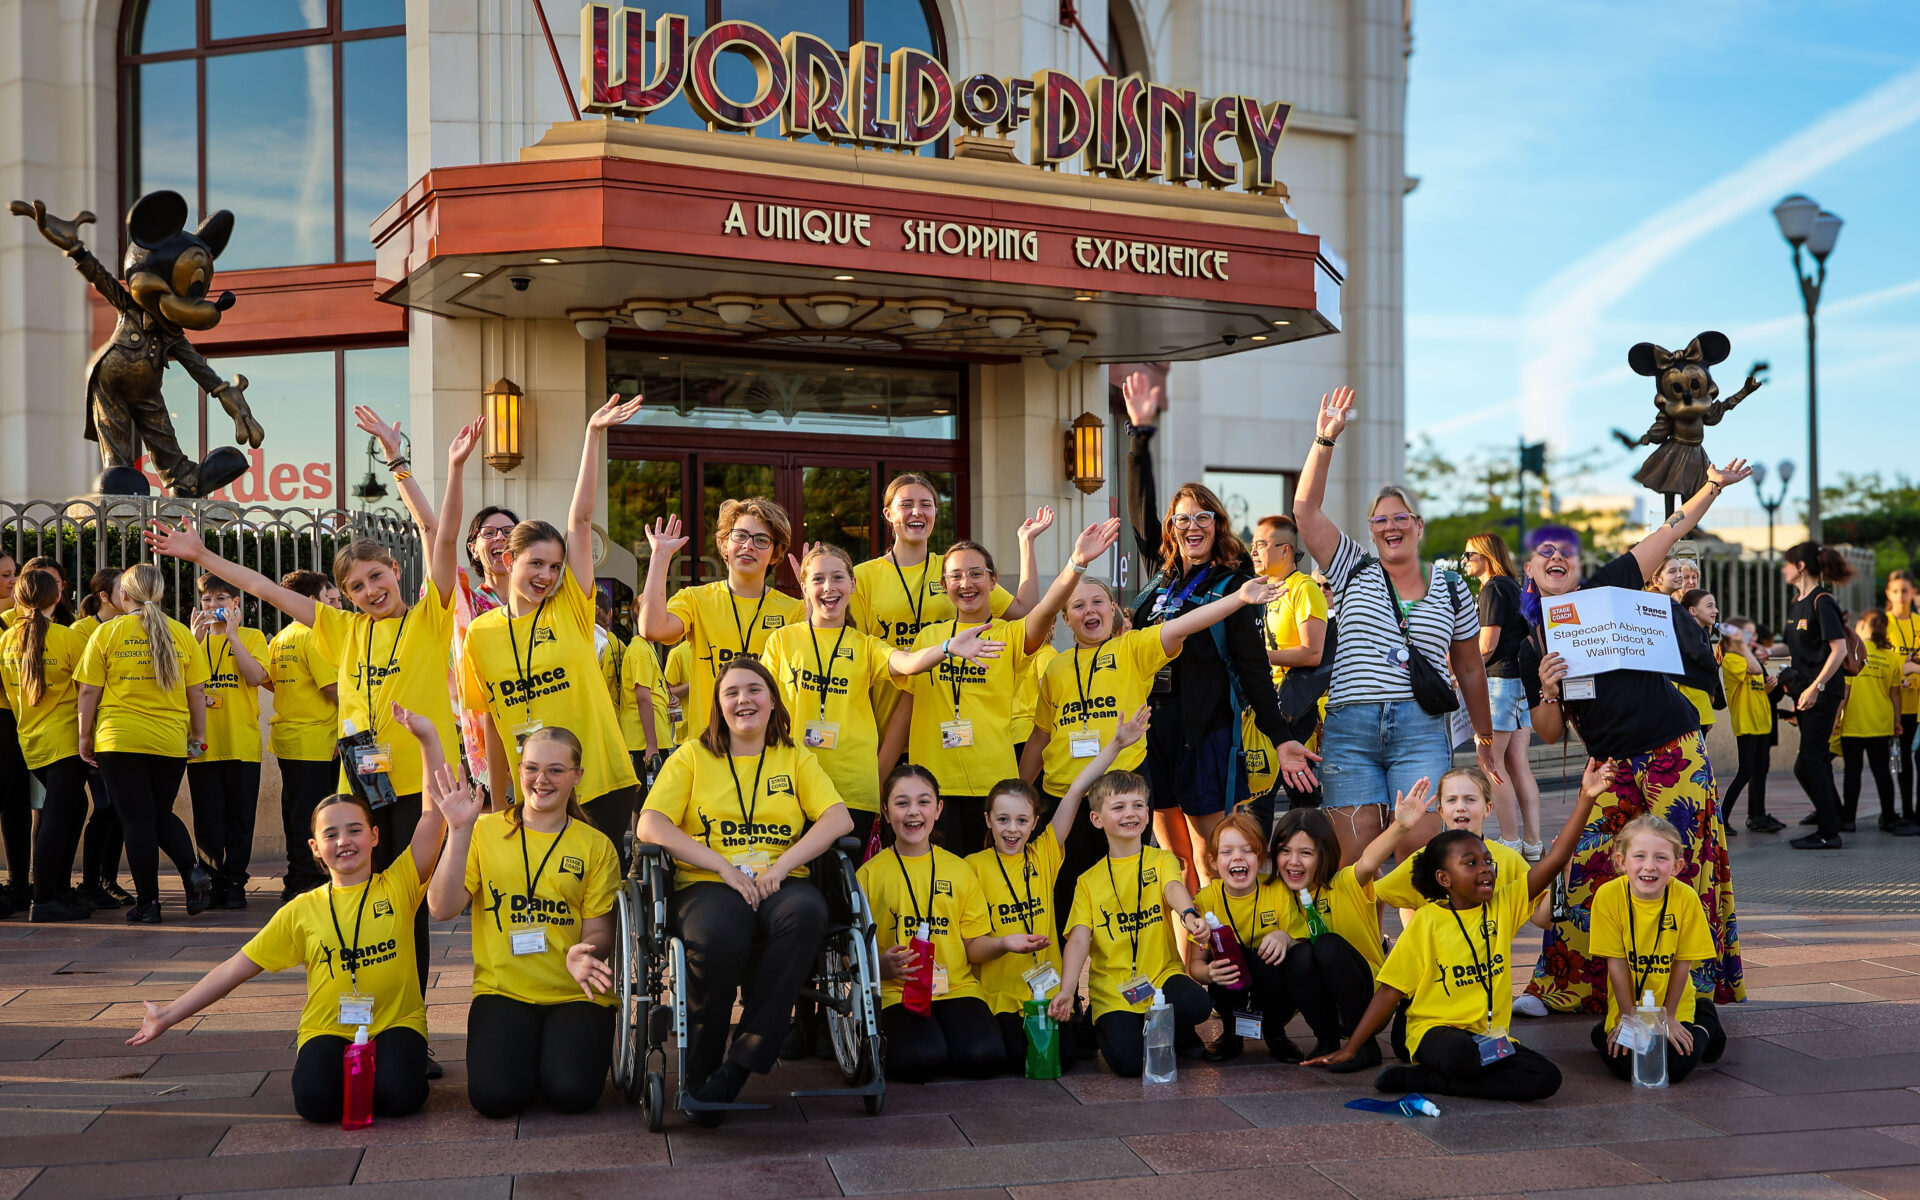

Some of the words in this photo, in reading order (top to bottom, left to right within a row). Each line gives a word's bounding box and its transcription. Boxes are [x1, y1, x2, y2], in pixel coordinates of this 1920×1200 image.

[581, 2, 955, 147] WORLD
[954, 73, 1035, 131] OF
[1031, 68, 1293, 188] DISNEY
[724, 202, 747, 236] A
[757, 204, 871, 247] UNIQUE
[903, 219, 1038, 262] SHOPPING
[1075, 237, 1229, 280] EXPERIENCE
[1552, 606, 1571, 615] STAGE
[1552, 612, 1572, 621] COACH
[1642, 605, 1667, 616] Dance
[1553, 621, 1617, 640] Stagecoach
[1619, 622, 1668, 638] Abingdon,
[896, 637, 914, 645] the
[1572, 636, 1609, 648] Botley,
[1612, 632, 1645, 645] Didcot
[1647, 637, 1655, 646] &
[1586, 646, 1646, 658] Wallingford
[940, 662, 986, 676] Dance
[499, 667, 565, 696] Dance
[803, 670, 848, 687] Dace
[956, 676, 986, 684] Dream
[801, 682, 815, 691] the
[504, 695, 526, 707] the
[528, 681, 570, 700] Dream
[1059, 715, 1076, 727] the
[720, 820, 792, 836] Dance
[721, 836, 746, 847] the
[748, 836, 790, 846] Dream
[564, 863, 581, 872] COACH
[565, 858, 581, 866] STAGE
[510, 912, 535, 923] the
[537, 913, 575, 926] Dream
[1000, 917, 1017, 925] the
[362, 951, 397, 968] Dream
[1455, 977, 1474, 988] the
